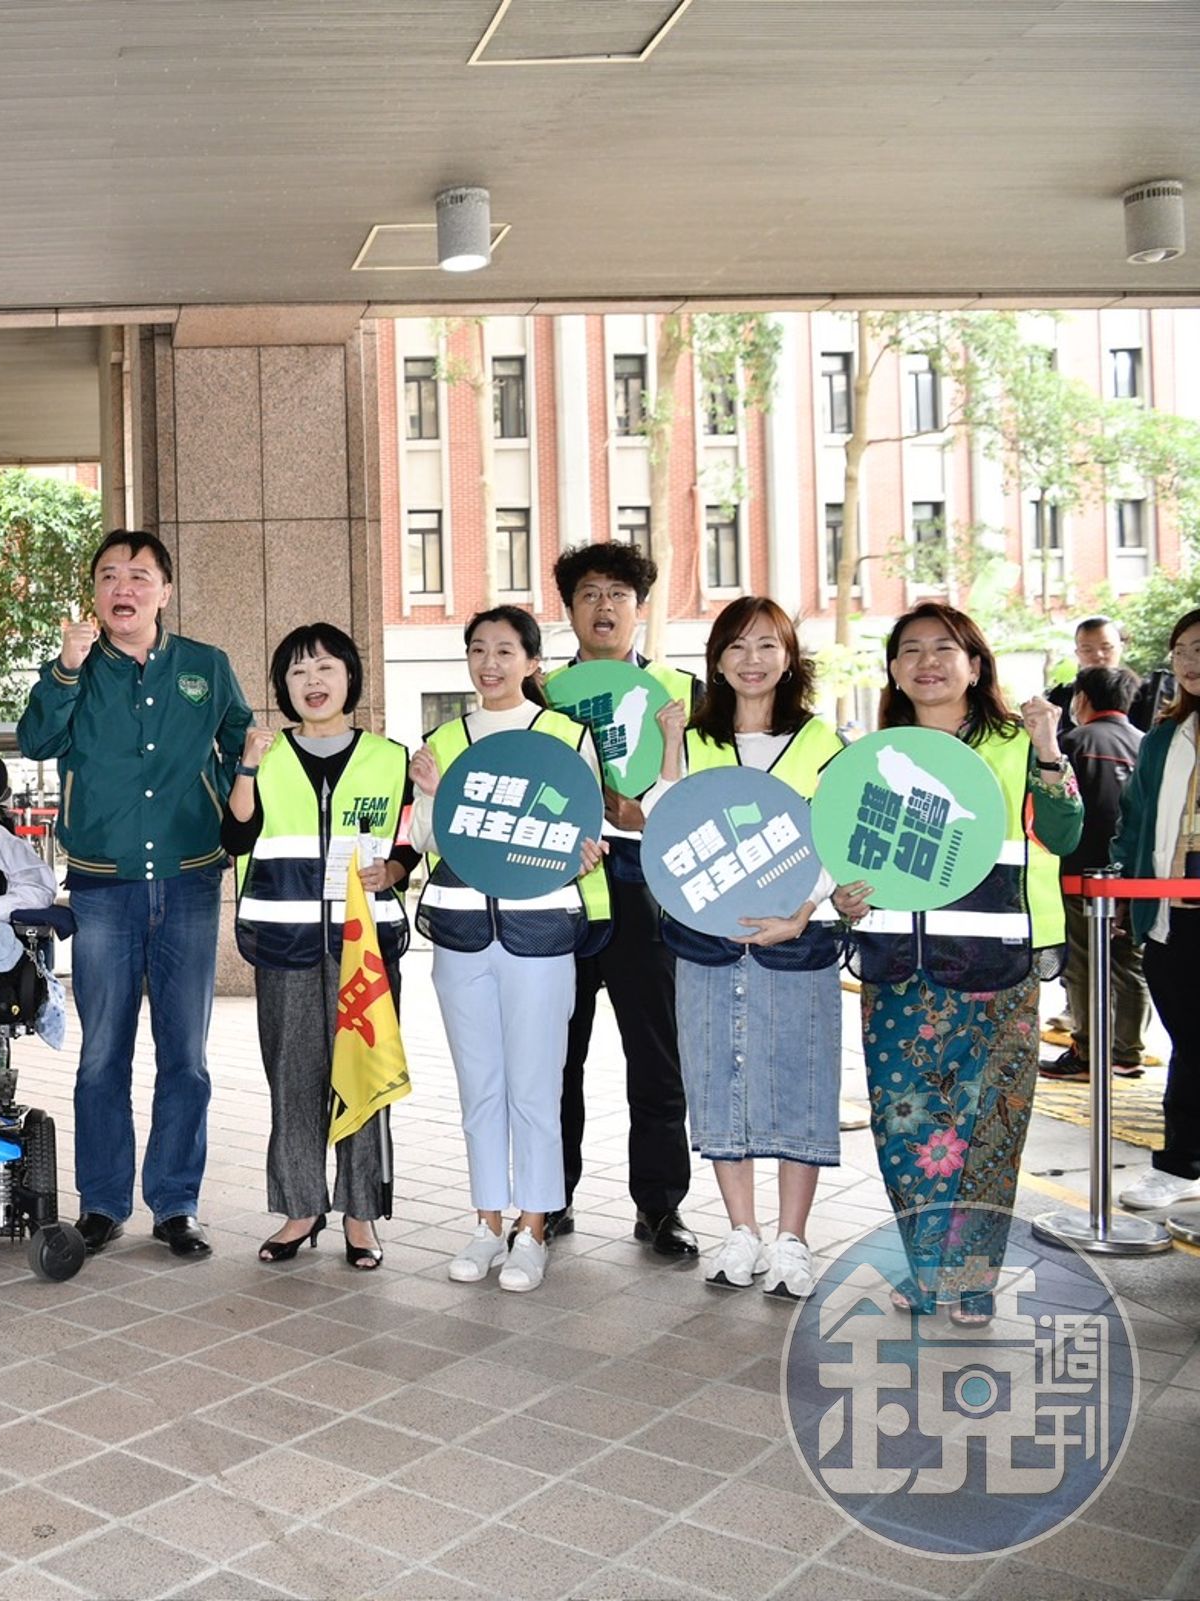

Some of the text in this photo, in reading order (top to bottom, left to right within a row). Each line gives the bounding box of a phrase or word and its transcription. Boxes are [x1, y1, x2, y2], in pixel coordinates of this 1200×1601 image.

[353, 796, 390, 811] TEAM
[462, 771, 529, 807] 守護
[448, 804, 581, 854] 民主自由
[662, 818, 728, 879] 守護
[847, 782, 905, 871] 守護
[893, 786, 951, 882] 台灣
[680, 812, 802, 913] 民主自由
